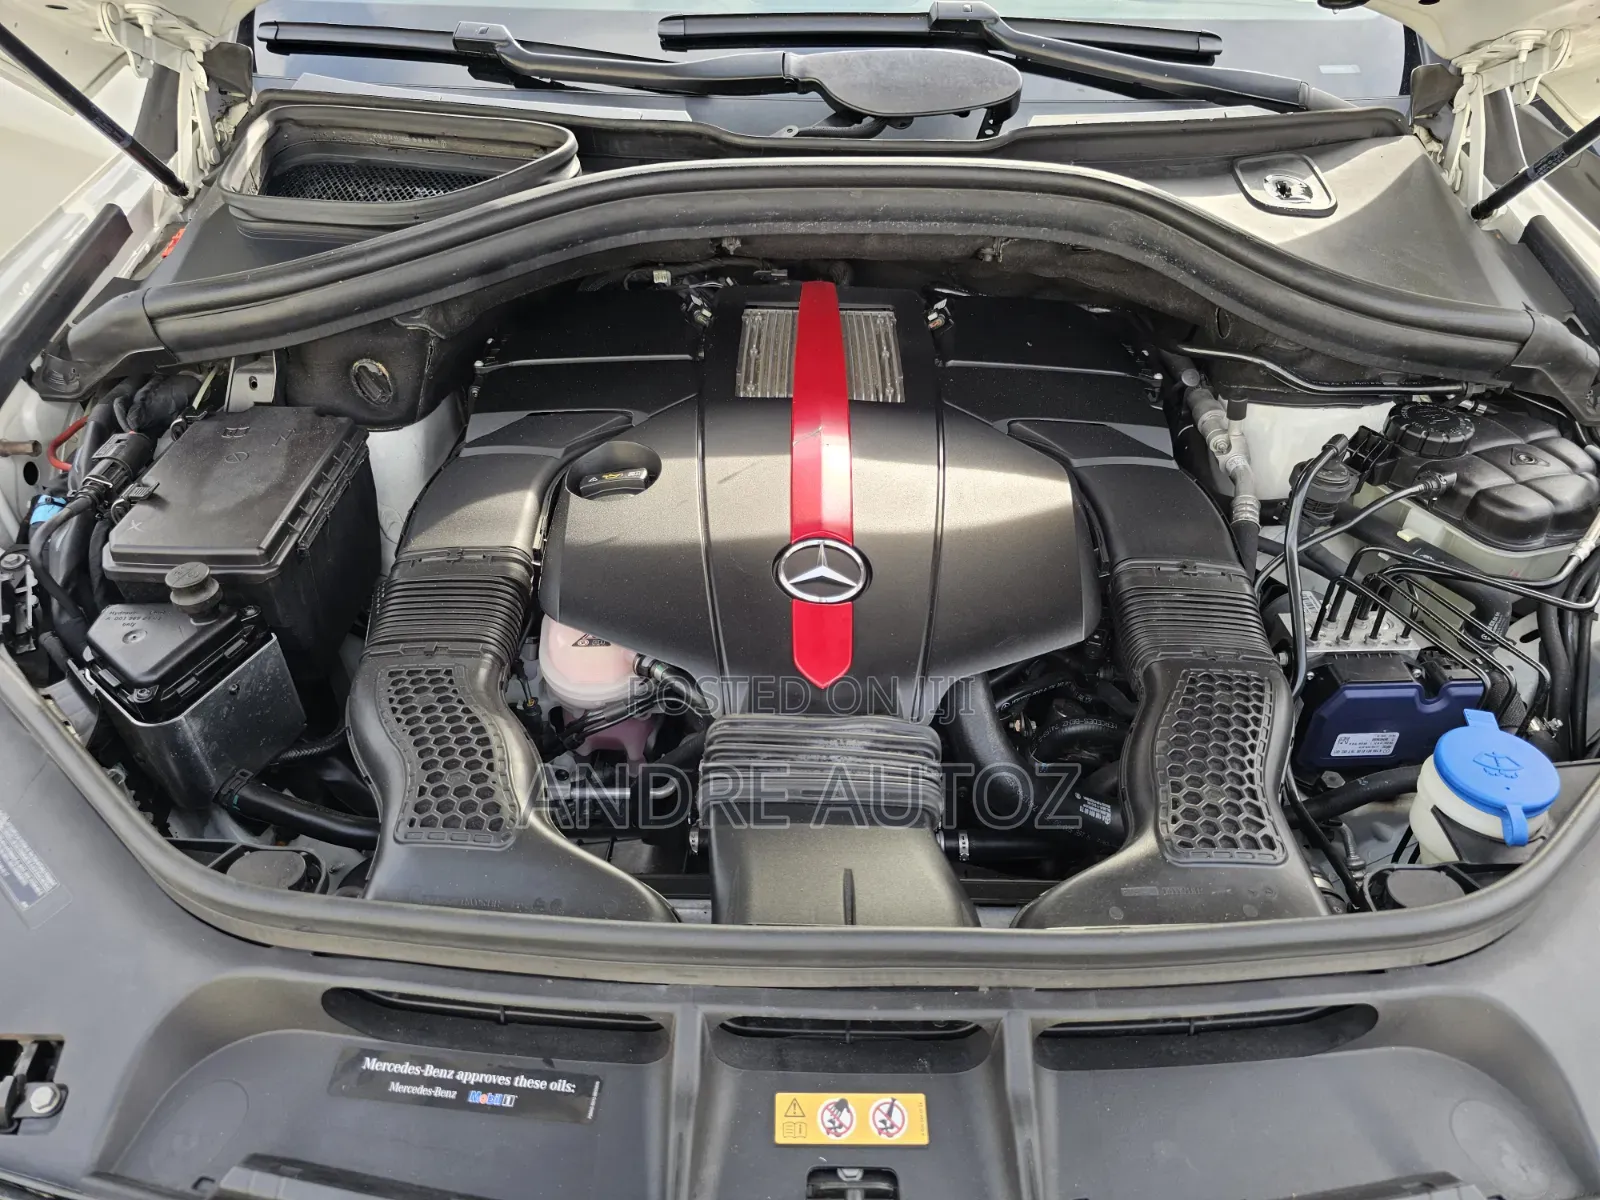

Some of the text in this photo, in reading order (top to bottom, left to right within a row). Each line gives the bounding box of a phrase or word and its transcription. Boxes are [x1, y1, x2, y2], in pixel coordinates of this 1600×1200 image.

[362, 1057, 576, 1093] Mercedes-Benz approves these oils:
[388, 1081, 457, 1099] Mercedes-Benz
